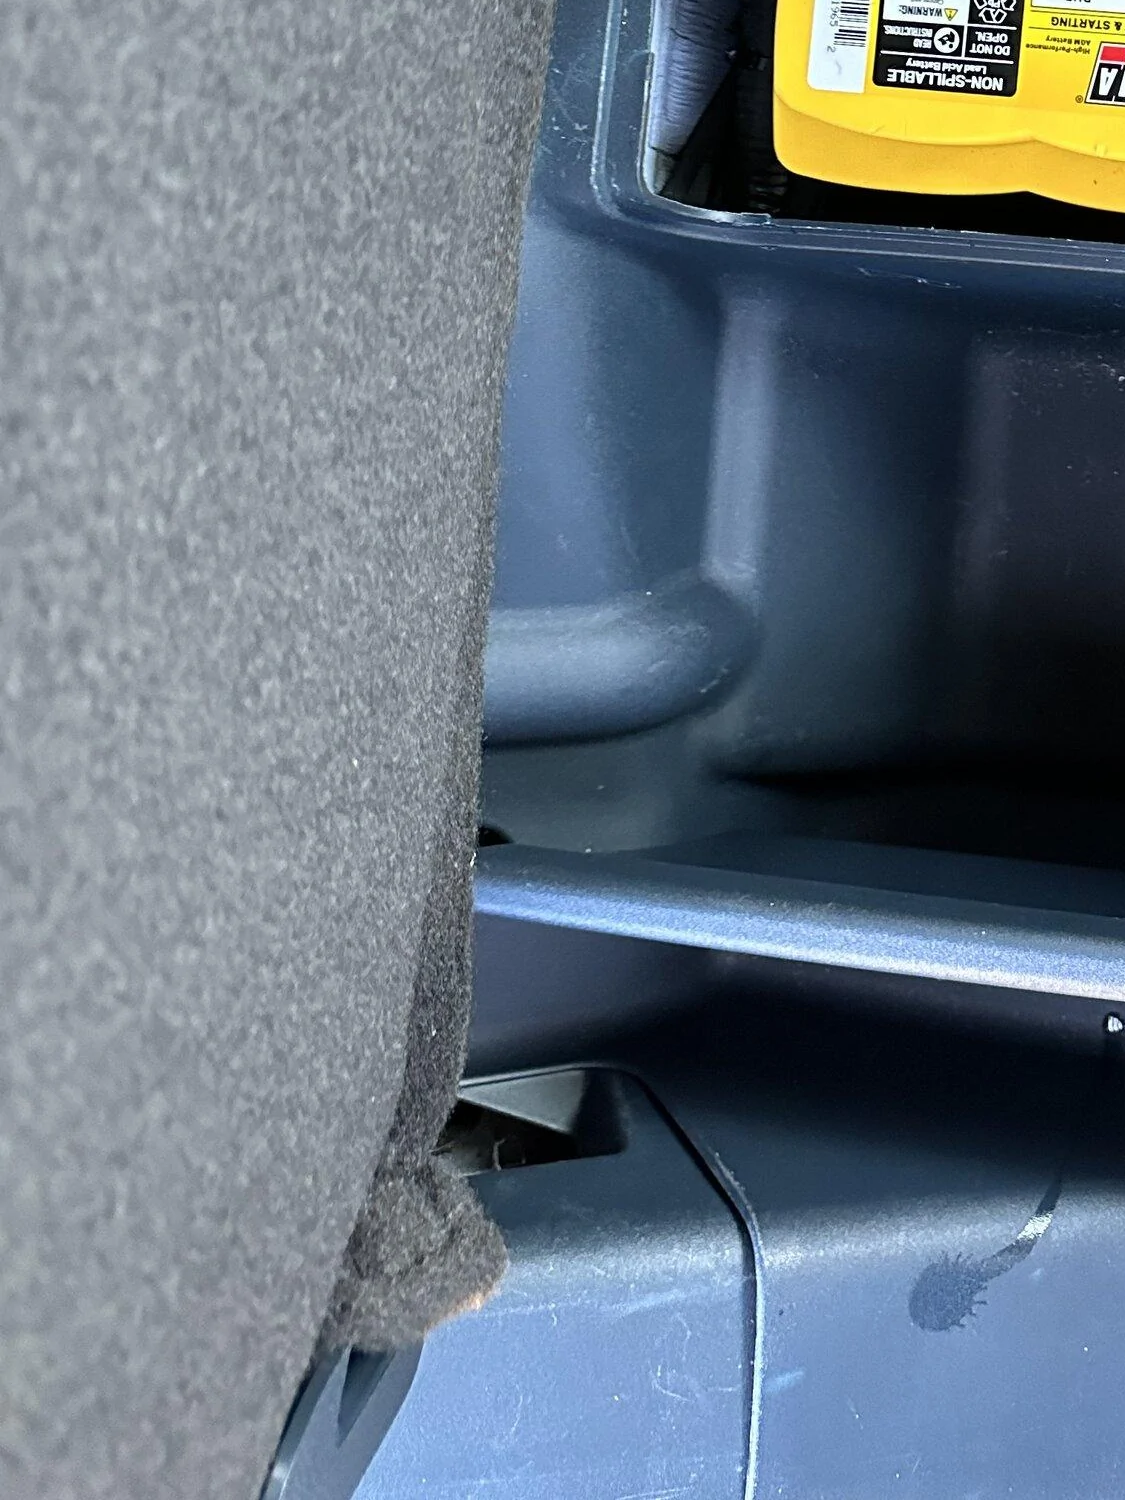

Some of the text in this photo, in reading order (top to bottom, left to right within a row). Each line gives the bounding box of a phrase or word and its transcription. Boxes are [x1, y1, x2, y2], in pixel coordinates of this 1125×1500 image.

[898, 4, 942, 17] WARNING:
[1050, 16, 1110, 30] STARTING
[1113, 21, 1121, 30] &
[882, 24, 932, 37] INSTRUCTIONS.
[974, 30, 1008, 43] OPEN.
[912, 38, 931, 48] READ
[1045, 35, 1072, 43] Battery
[969, 43, 1010, 55] DO NOT
[1025, 42, 1090, 54] High-Performance
[905, 57, 986, 74] Lead Acid Battery
[886, 67, 1003, 91] NON-SPILLABLE
